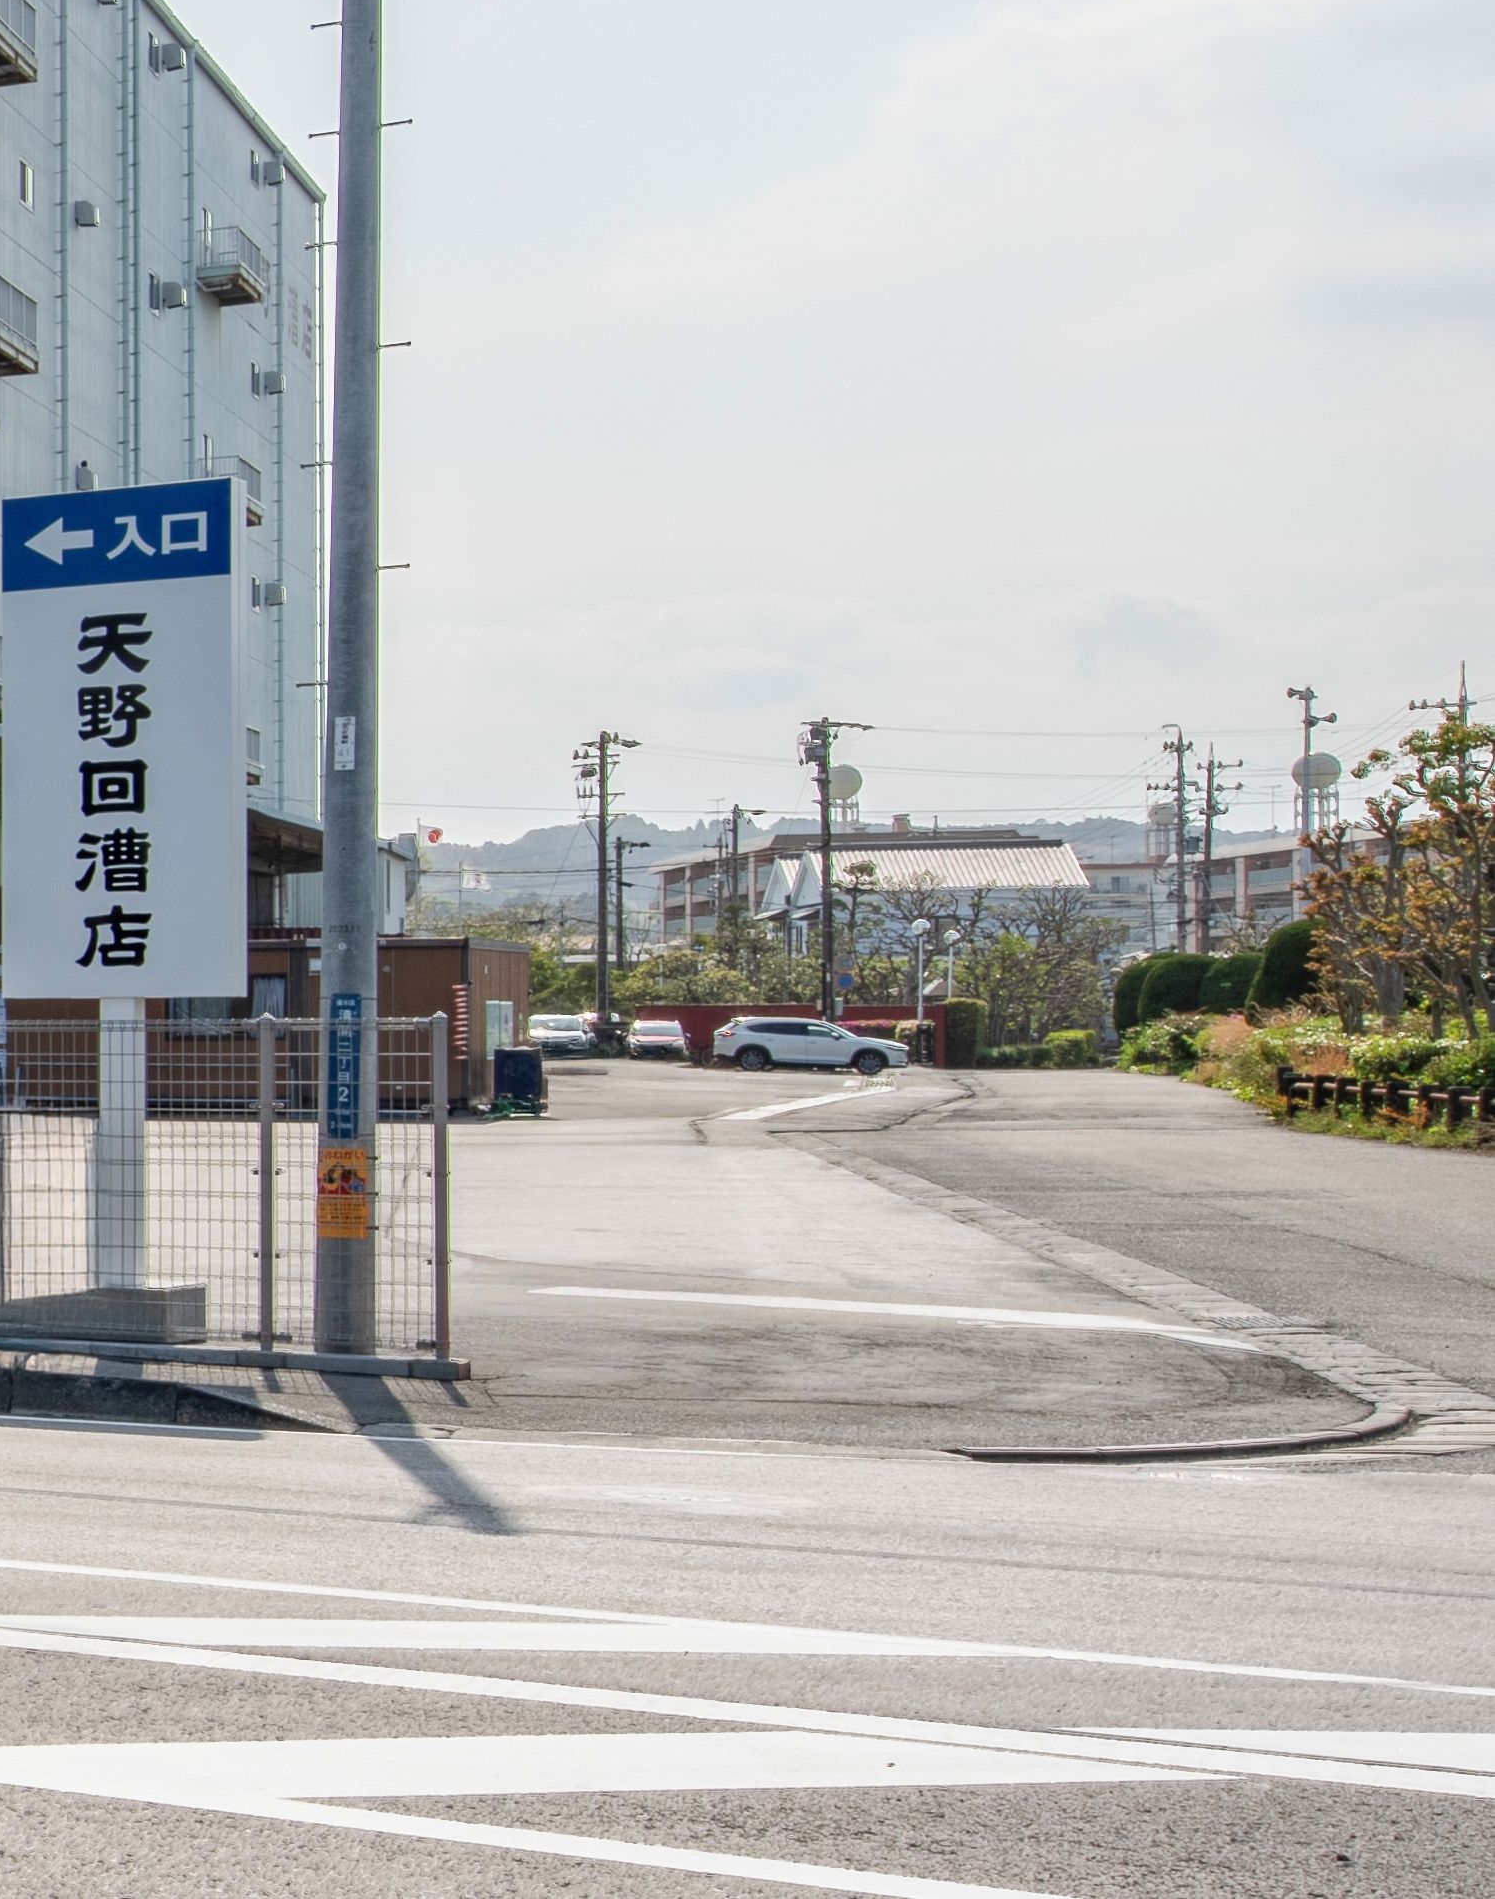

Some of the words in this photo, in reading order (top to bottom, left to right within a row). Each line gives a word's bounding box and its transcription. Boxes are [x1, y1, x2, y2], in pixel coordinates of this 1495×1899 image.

[106, 510, 208, 560] 入口
[75, 612, 153, 968] 天野回漕店
